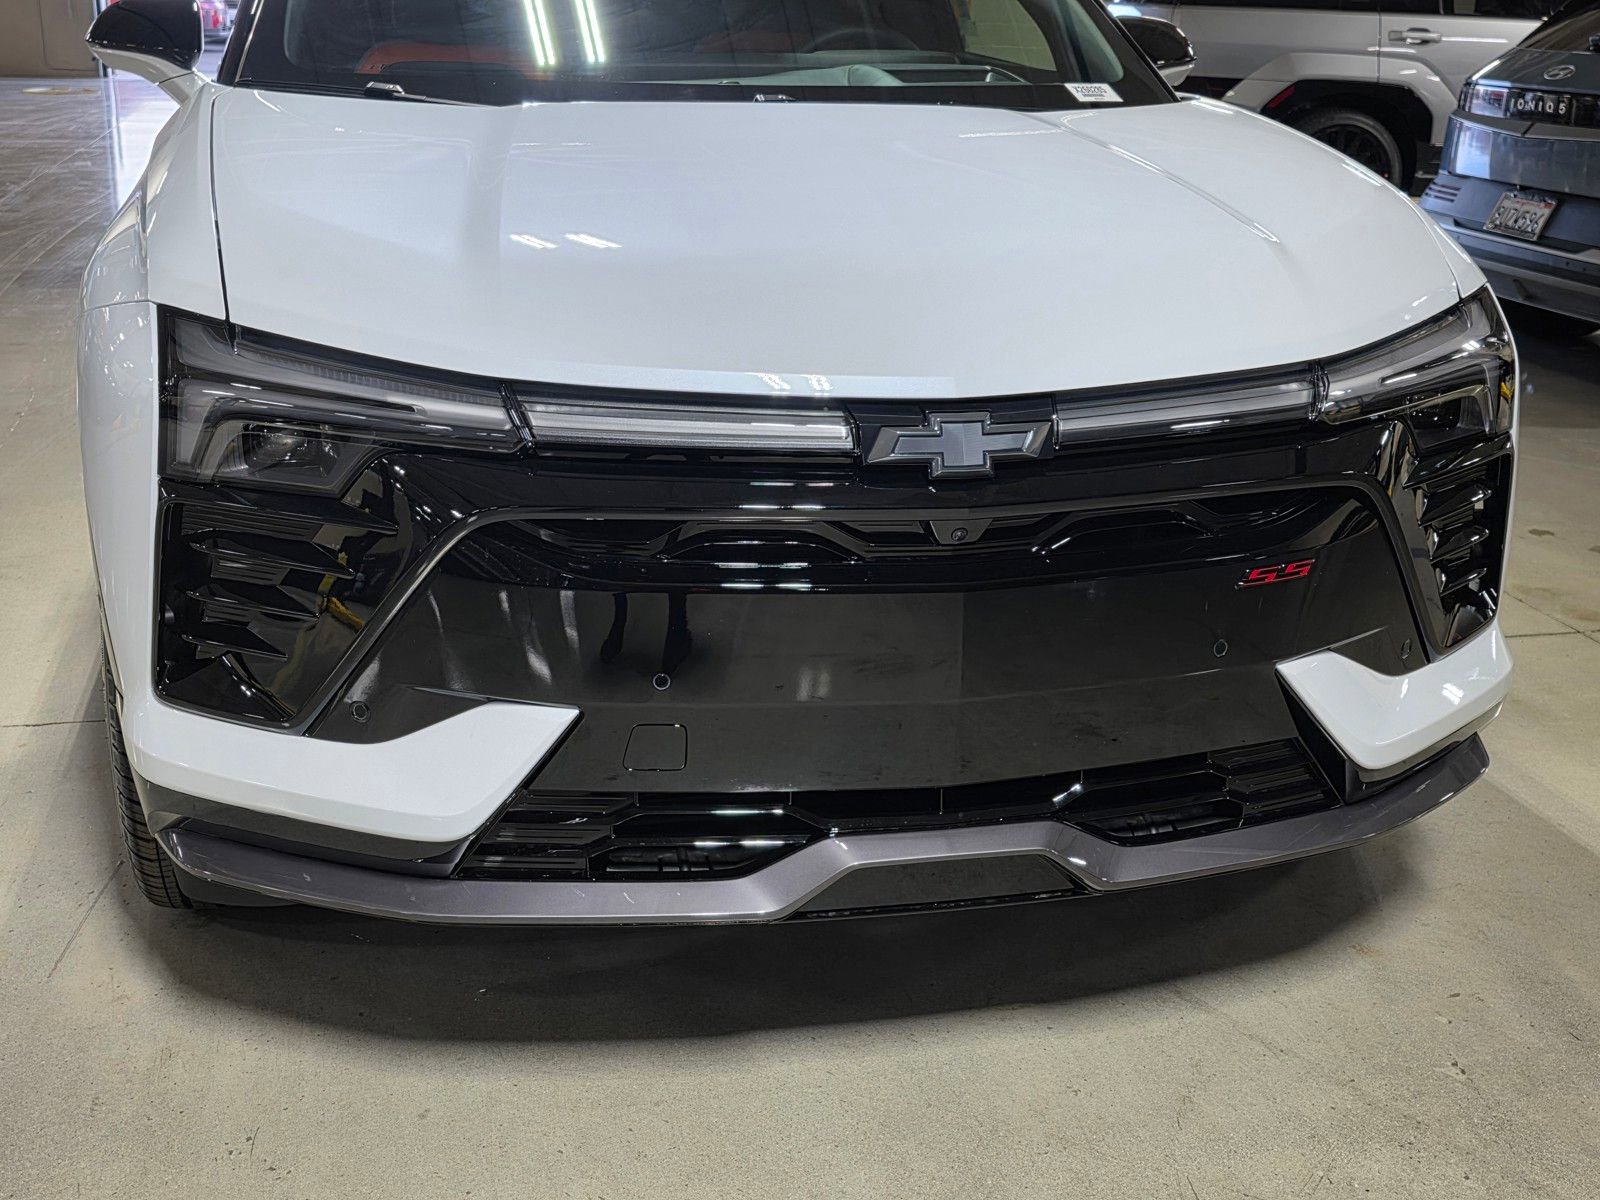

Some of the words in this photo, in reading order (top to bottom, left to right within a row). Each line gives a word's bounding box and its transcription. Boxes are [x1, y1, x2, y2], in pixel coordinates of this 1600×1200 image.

[1510, 98, 1554, 113] IONIQ
[1558, 102, 1567, 115] 5
[1237, 558, 1316, 588] SS
